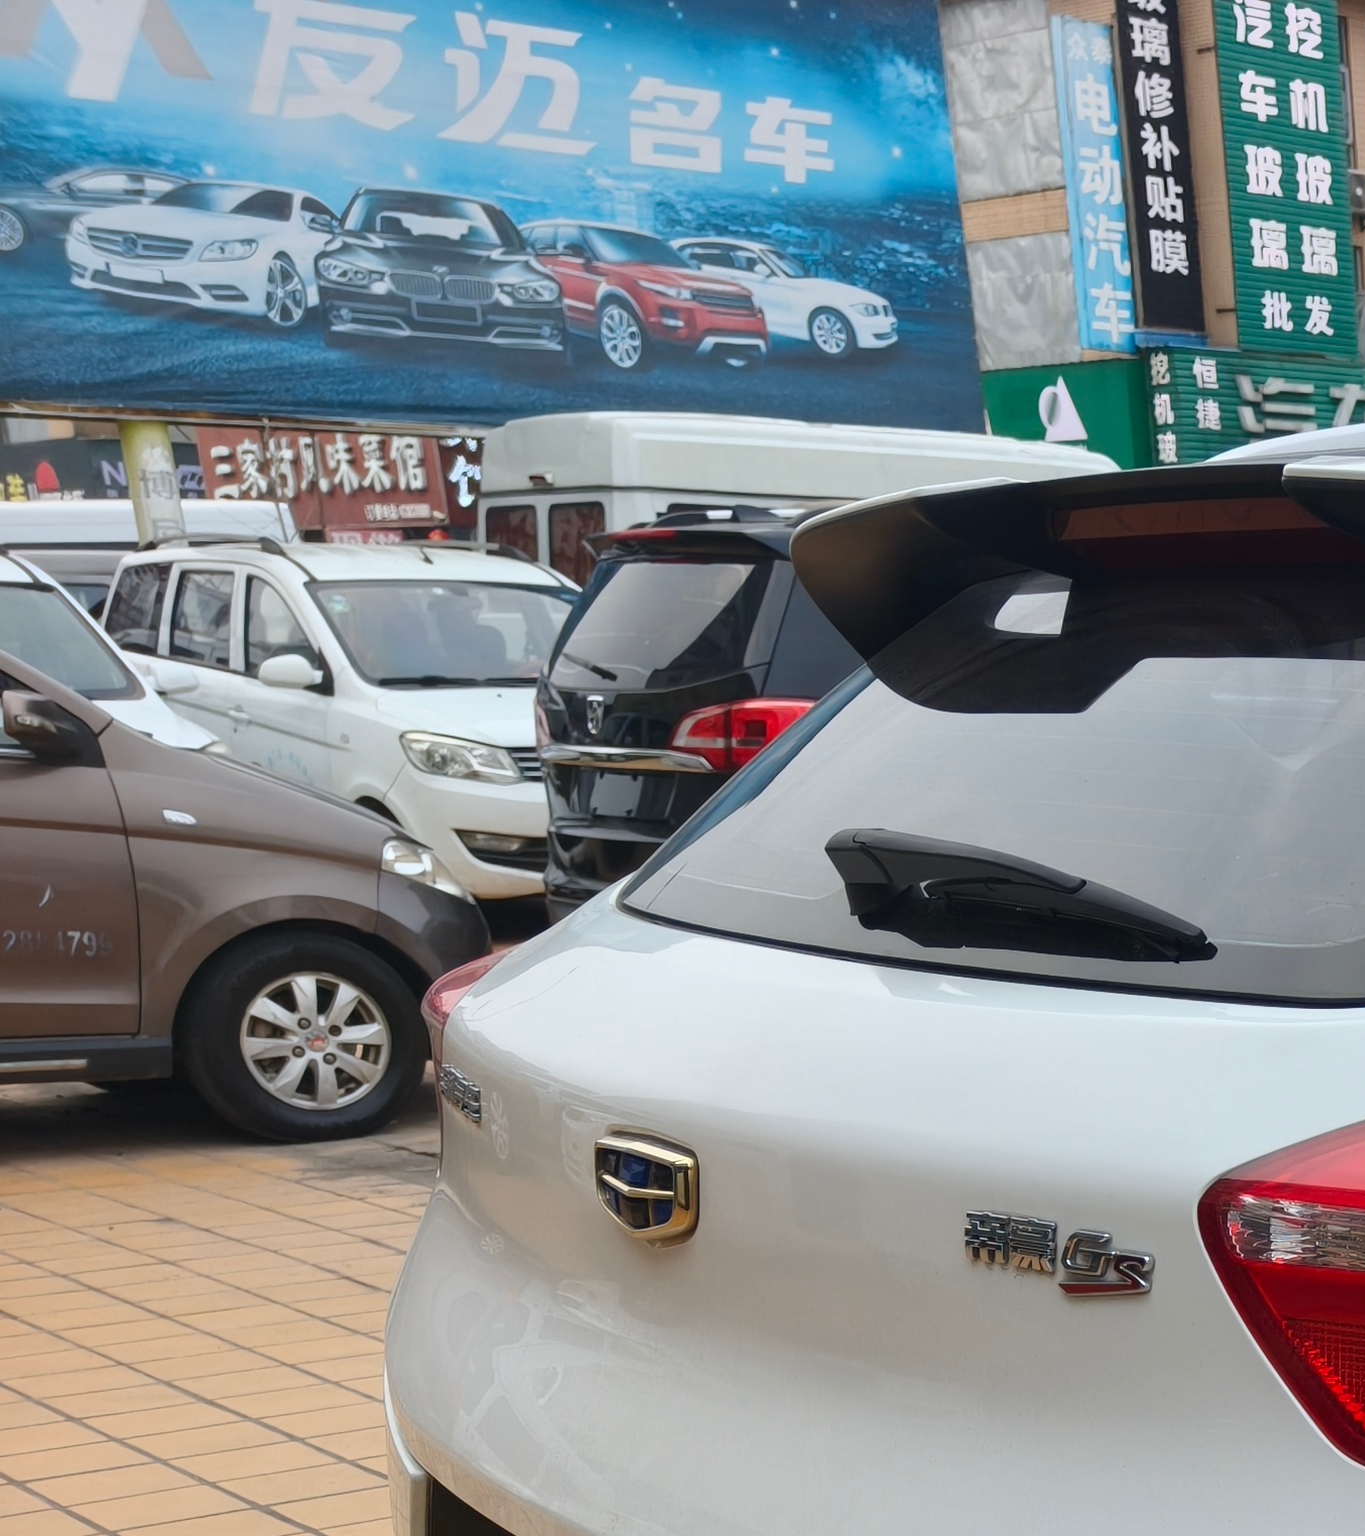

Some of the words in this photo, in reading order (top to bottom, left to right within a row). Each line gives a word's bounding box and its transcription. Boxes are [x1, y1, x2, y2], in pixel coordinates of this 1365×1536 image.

[1285, 2, 1339, 277] 挖机玻璃
[1074, 73, 1134, 345] 电动汽车
[1261, 290, 1335, 337] 批发
[1193, 356, 1222, 431] 恒捷
[964, 1210, 1058, 1274] 帝豪
[1058, 1229, 1155, 1296] GS
